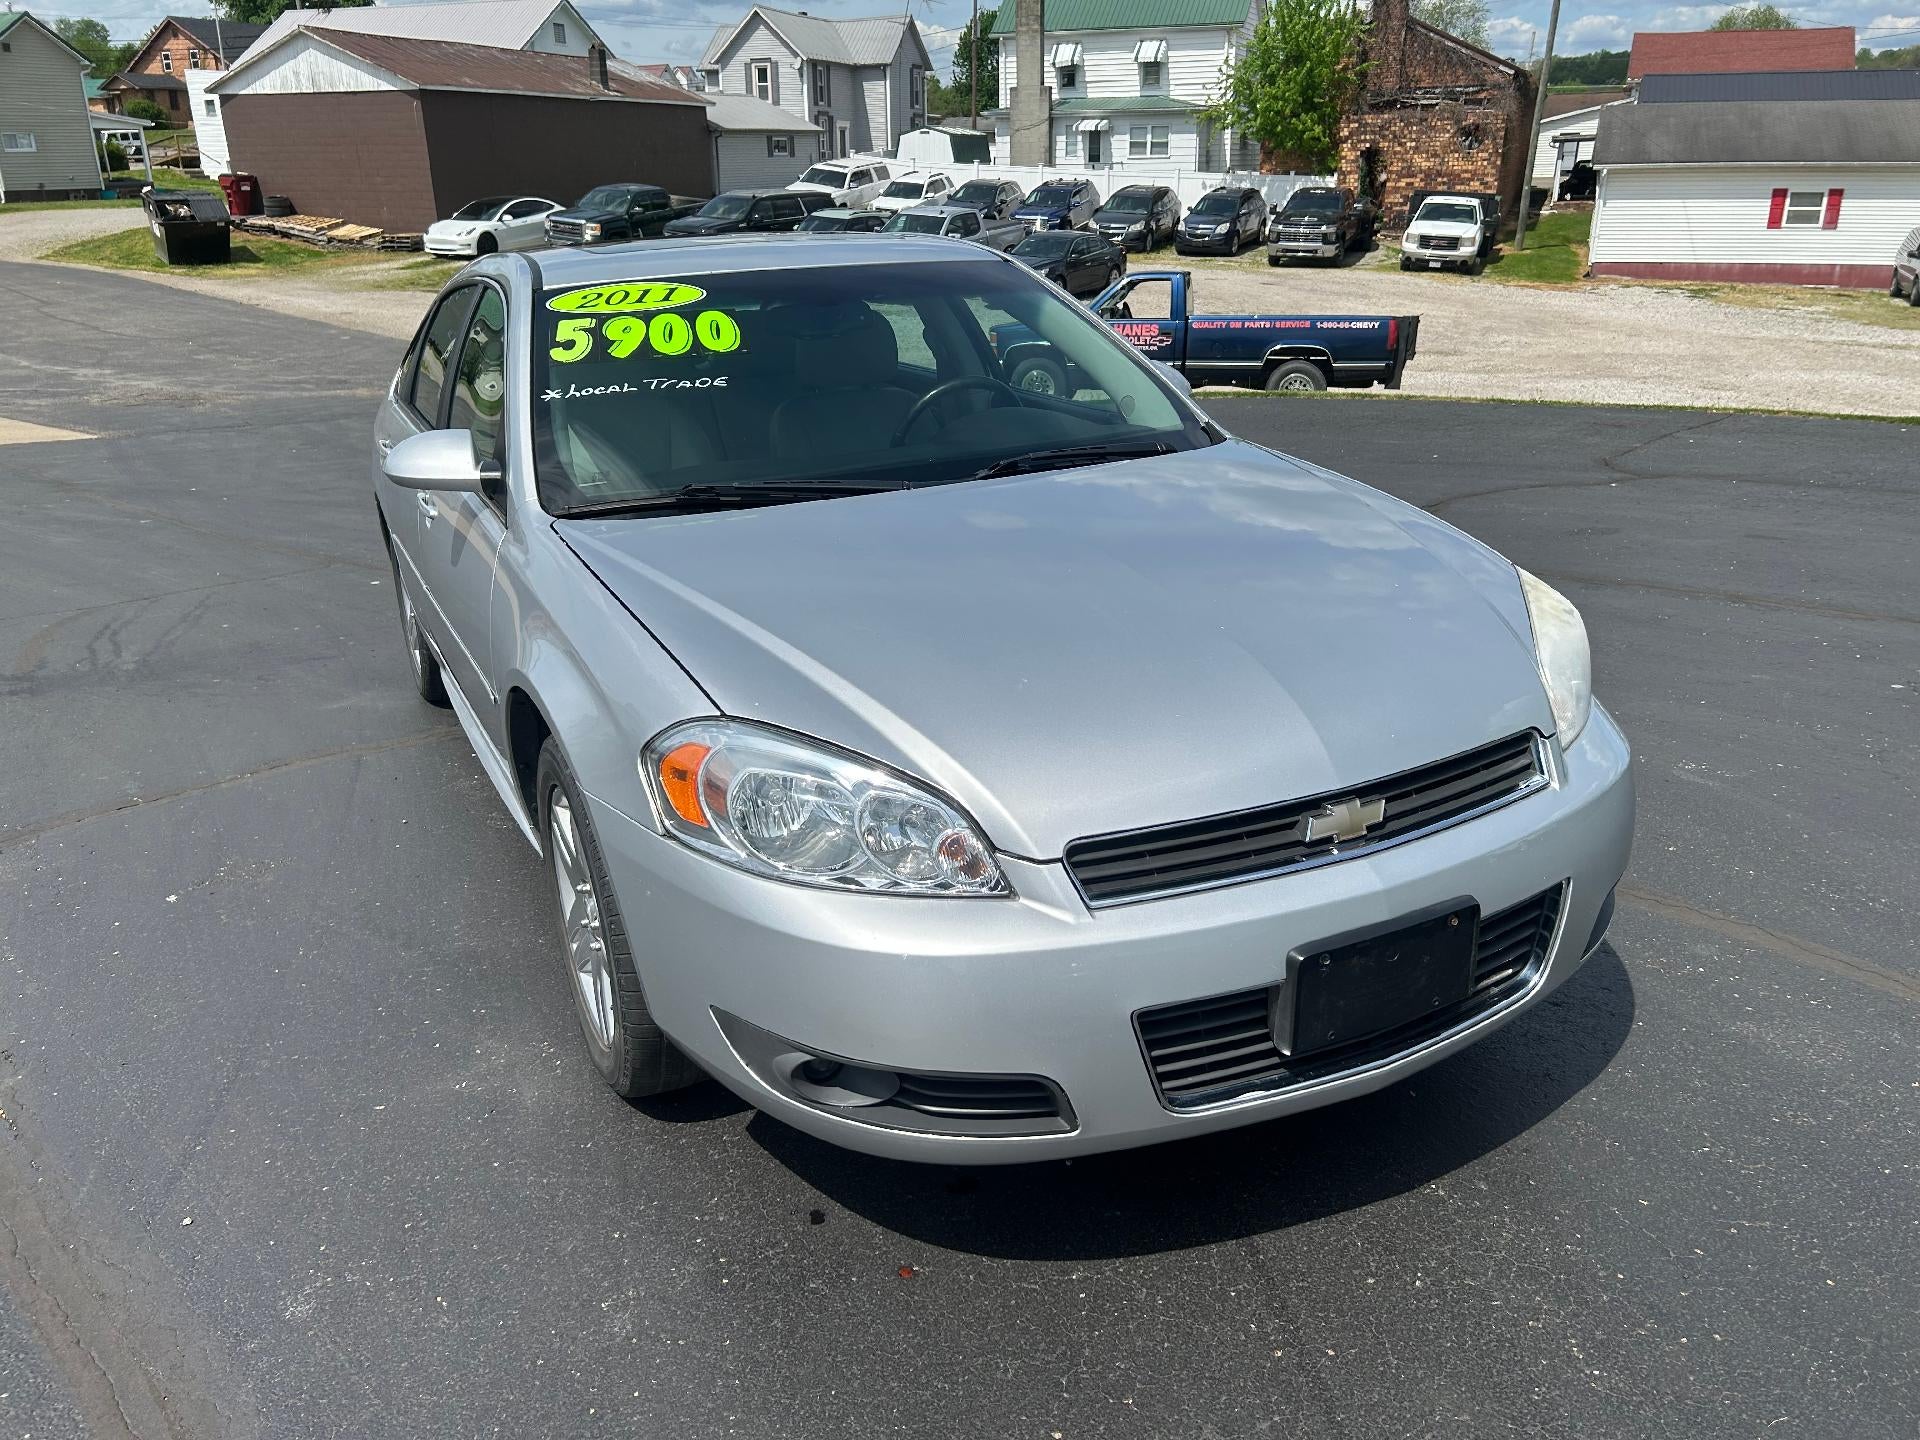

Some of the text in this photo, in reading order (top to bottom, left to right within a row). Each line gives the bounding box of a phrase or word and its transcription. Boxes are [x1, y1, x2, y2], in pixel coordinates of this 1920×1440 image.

[575, 286, 679, 309] 2011
[1113, 323, 1159, 336] HANES
[1192, 321, 1227, 329] QUALITY
[550, 310, 741, 363] 5900
